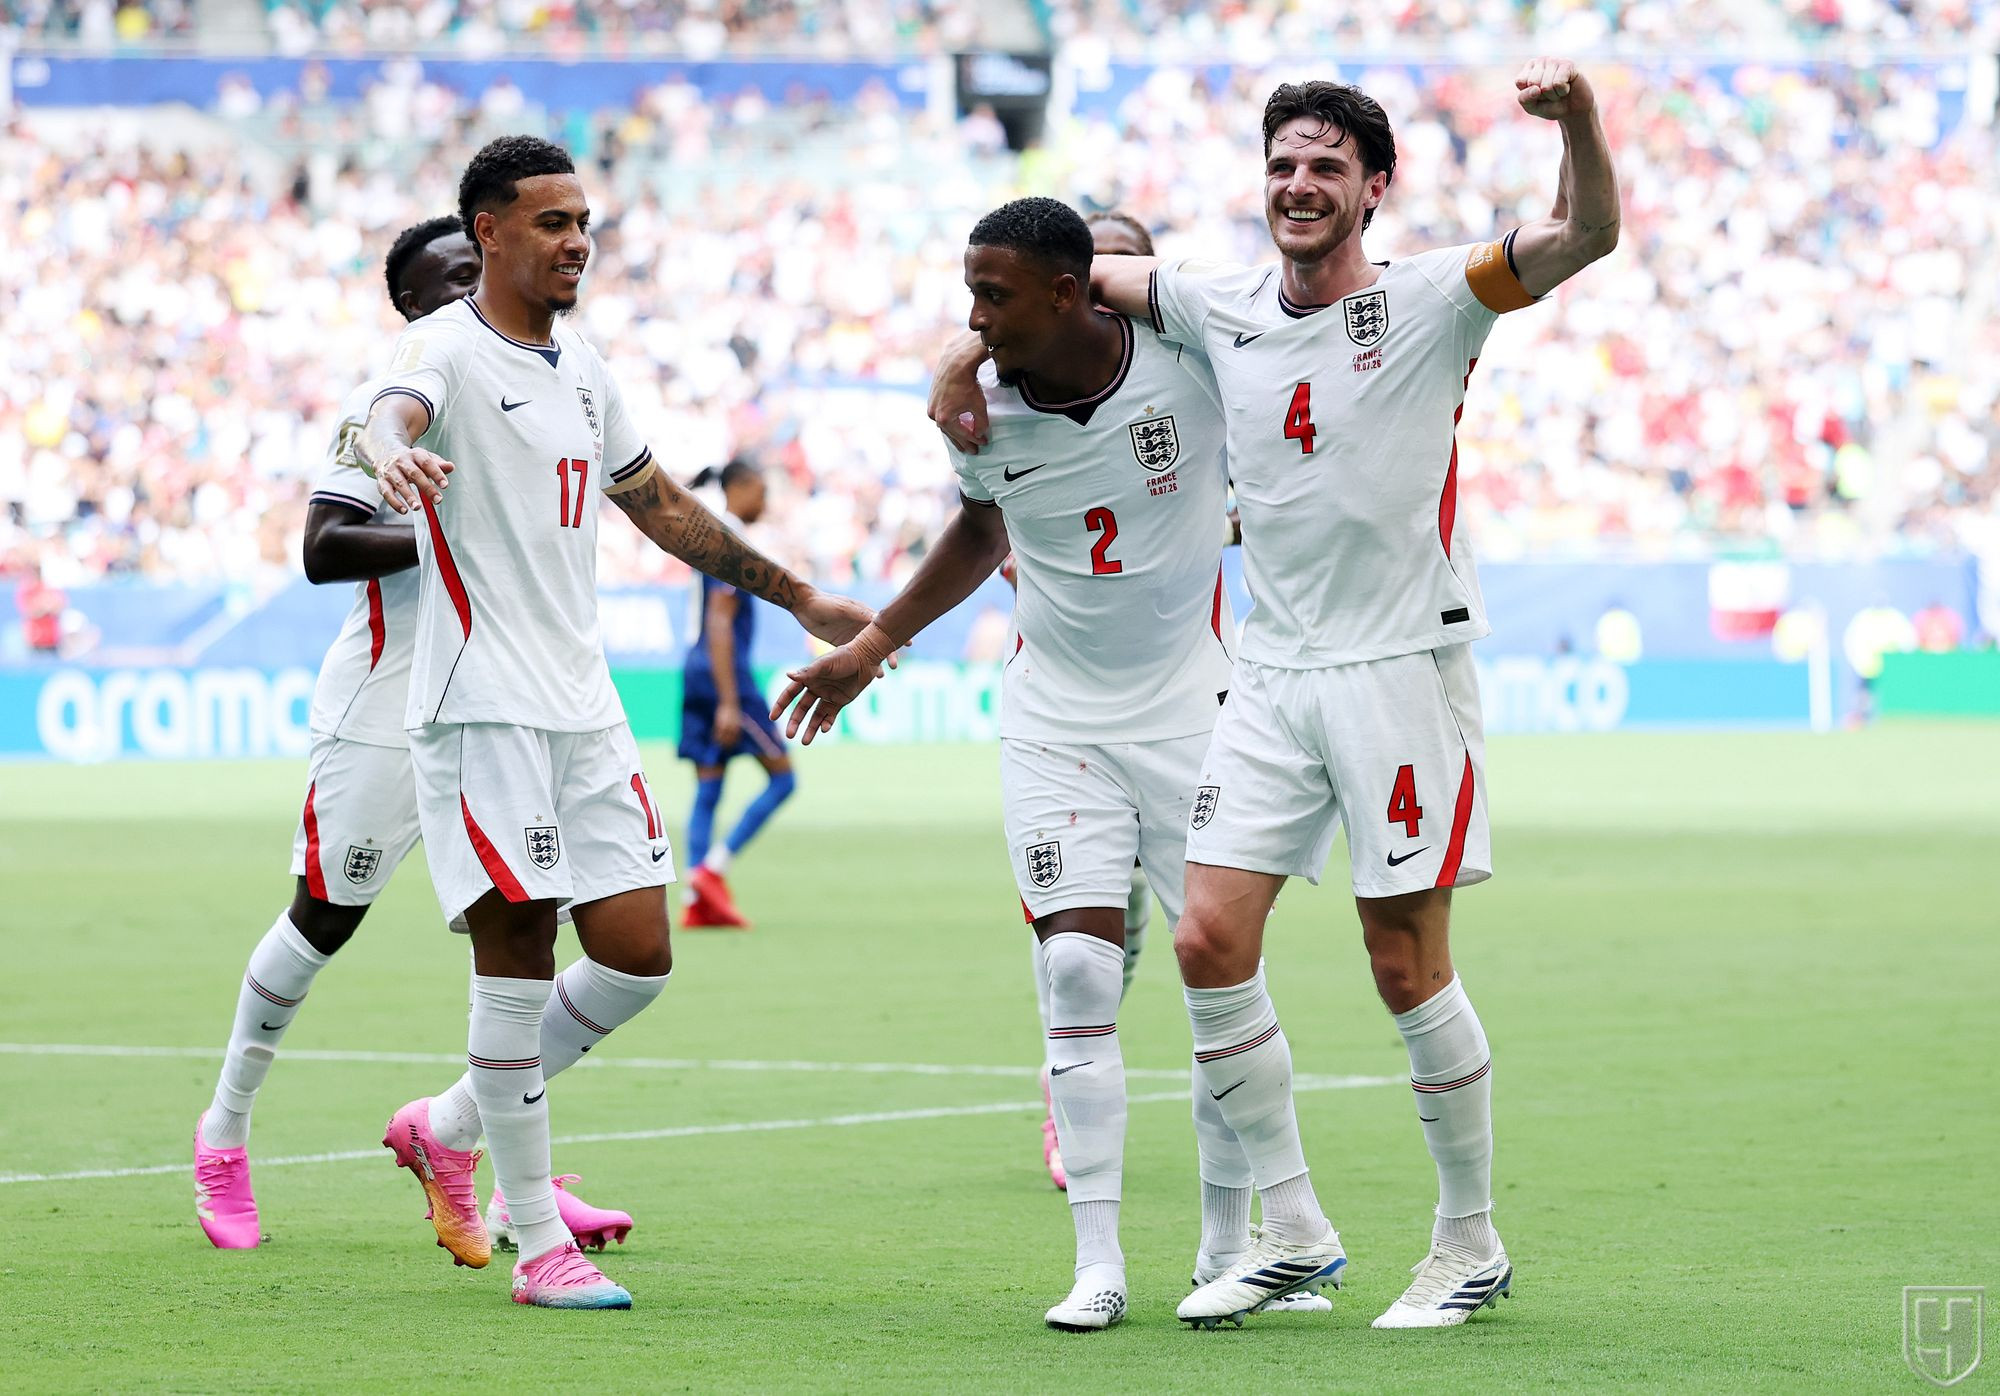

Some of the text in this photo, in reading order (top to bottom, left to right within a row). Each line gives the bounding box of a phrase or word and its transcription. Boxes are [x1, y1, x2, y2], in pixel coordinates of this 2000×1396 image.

[1352, 349, 1383, 362] FRANCE
[1353, 360, 1382, 372] 18.07.26
[1284, 382, 1317, 454] 4
[557, 457, 588, 529] 17
[1146, 472, 1177, 488] FRANCE
[1150, 482, 1178, 496] 18.07.26
[1084, 506, 1122, 575] 2
[37, 666, 312, 757] aramc
[1387, 764, 1423, 838] 4
